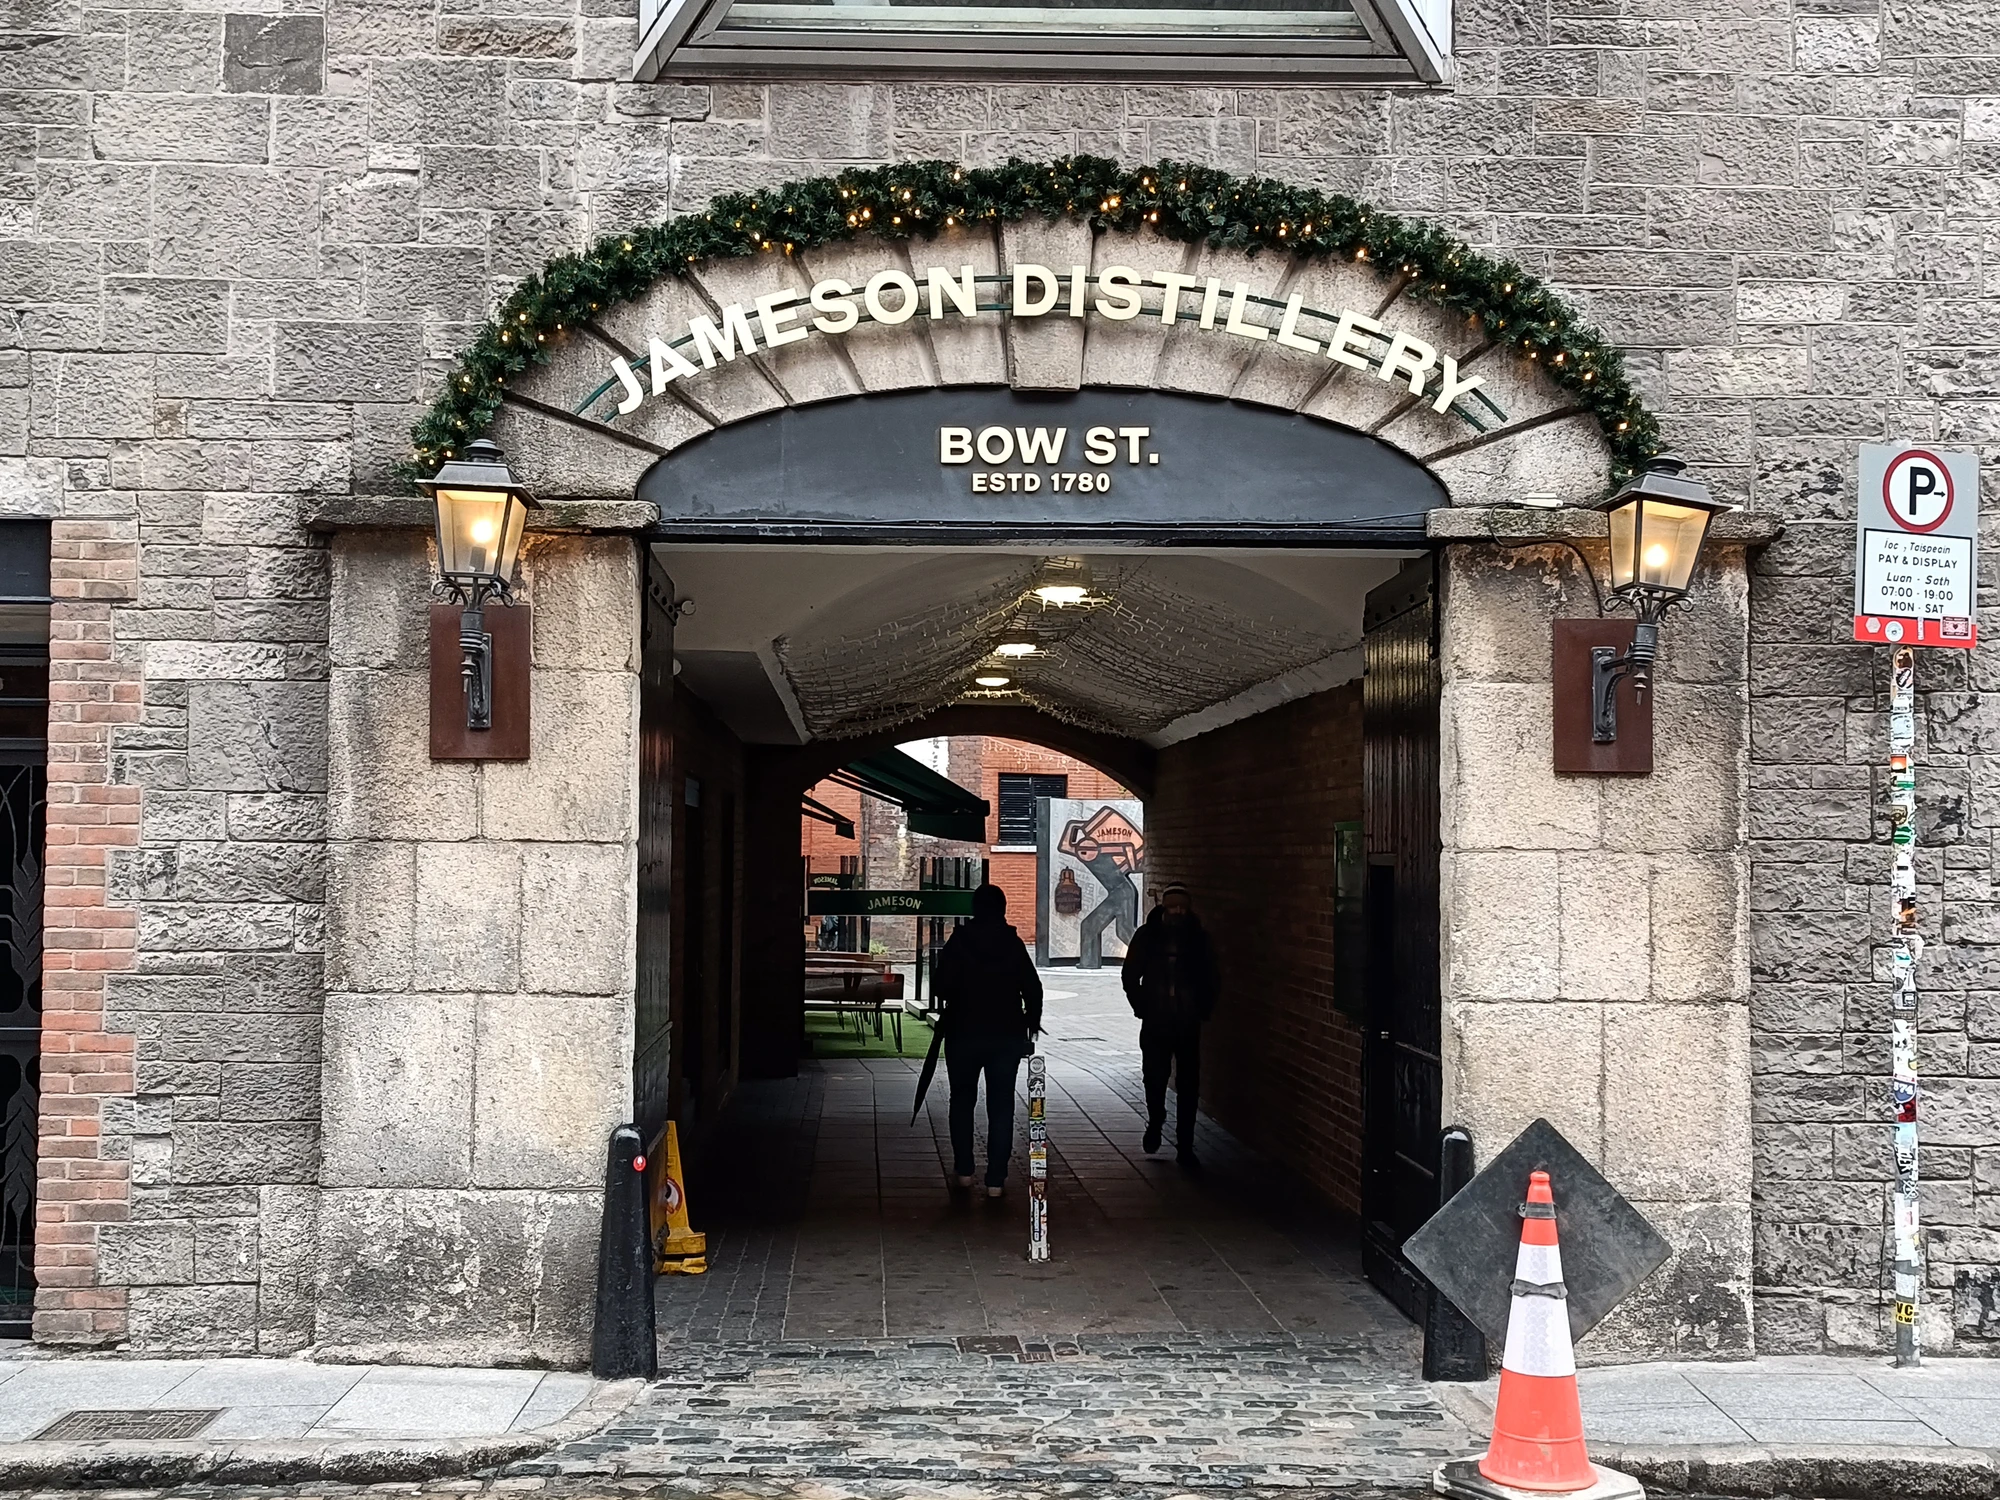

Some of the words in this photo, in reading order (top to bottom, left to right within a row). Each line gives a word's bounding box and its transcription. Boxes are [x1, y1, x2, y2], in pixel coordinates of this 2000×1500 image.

[610, 265, 977, 415] JAMESON
[1012, 263, 1487, 415] DISTILLERY
[940, 425, 1068, 465] BOW
[1084, 425, 1160, 465] ST.
[972, 472, 1041, 493] ESTD
[1050, 472, 1111, 493] 1780
[1909, 466, 1936, 515] P
[1878, 553, 1899, 564] PAY
[1902, 556, 1909, 565] &
[1912, 556, 1958, 569] DISPLAY
[1886, 572, 1912, 583] Luan
[1925, 575, 1950, 586] Sath
[1881, 585, 1913, 598] 07:00
[1924, 589, 1954, 601] 19:00
[1890, 600, 1915, 612] MON
[1925, 603, 1944, 614] SAT
[1097, 827, 1133, 838] JAMESON
[867, 896, 922, 910] JAMESON
